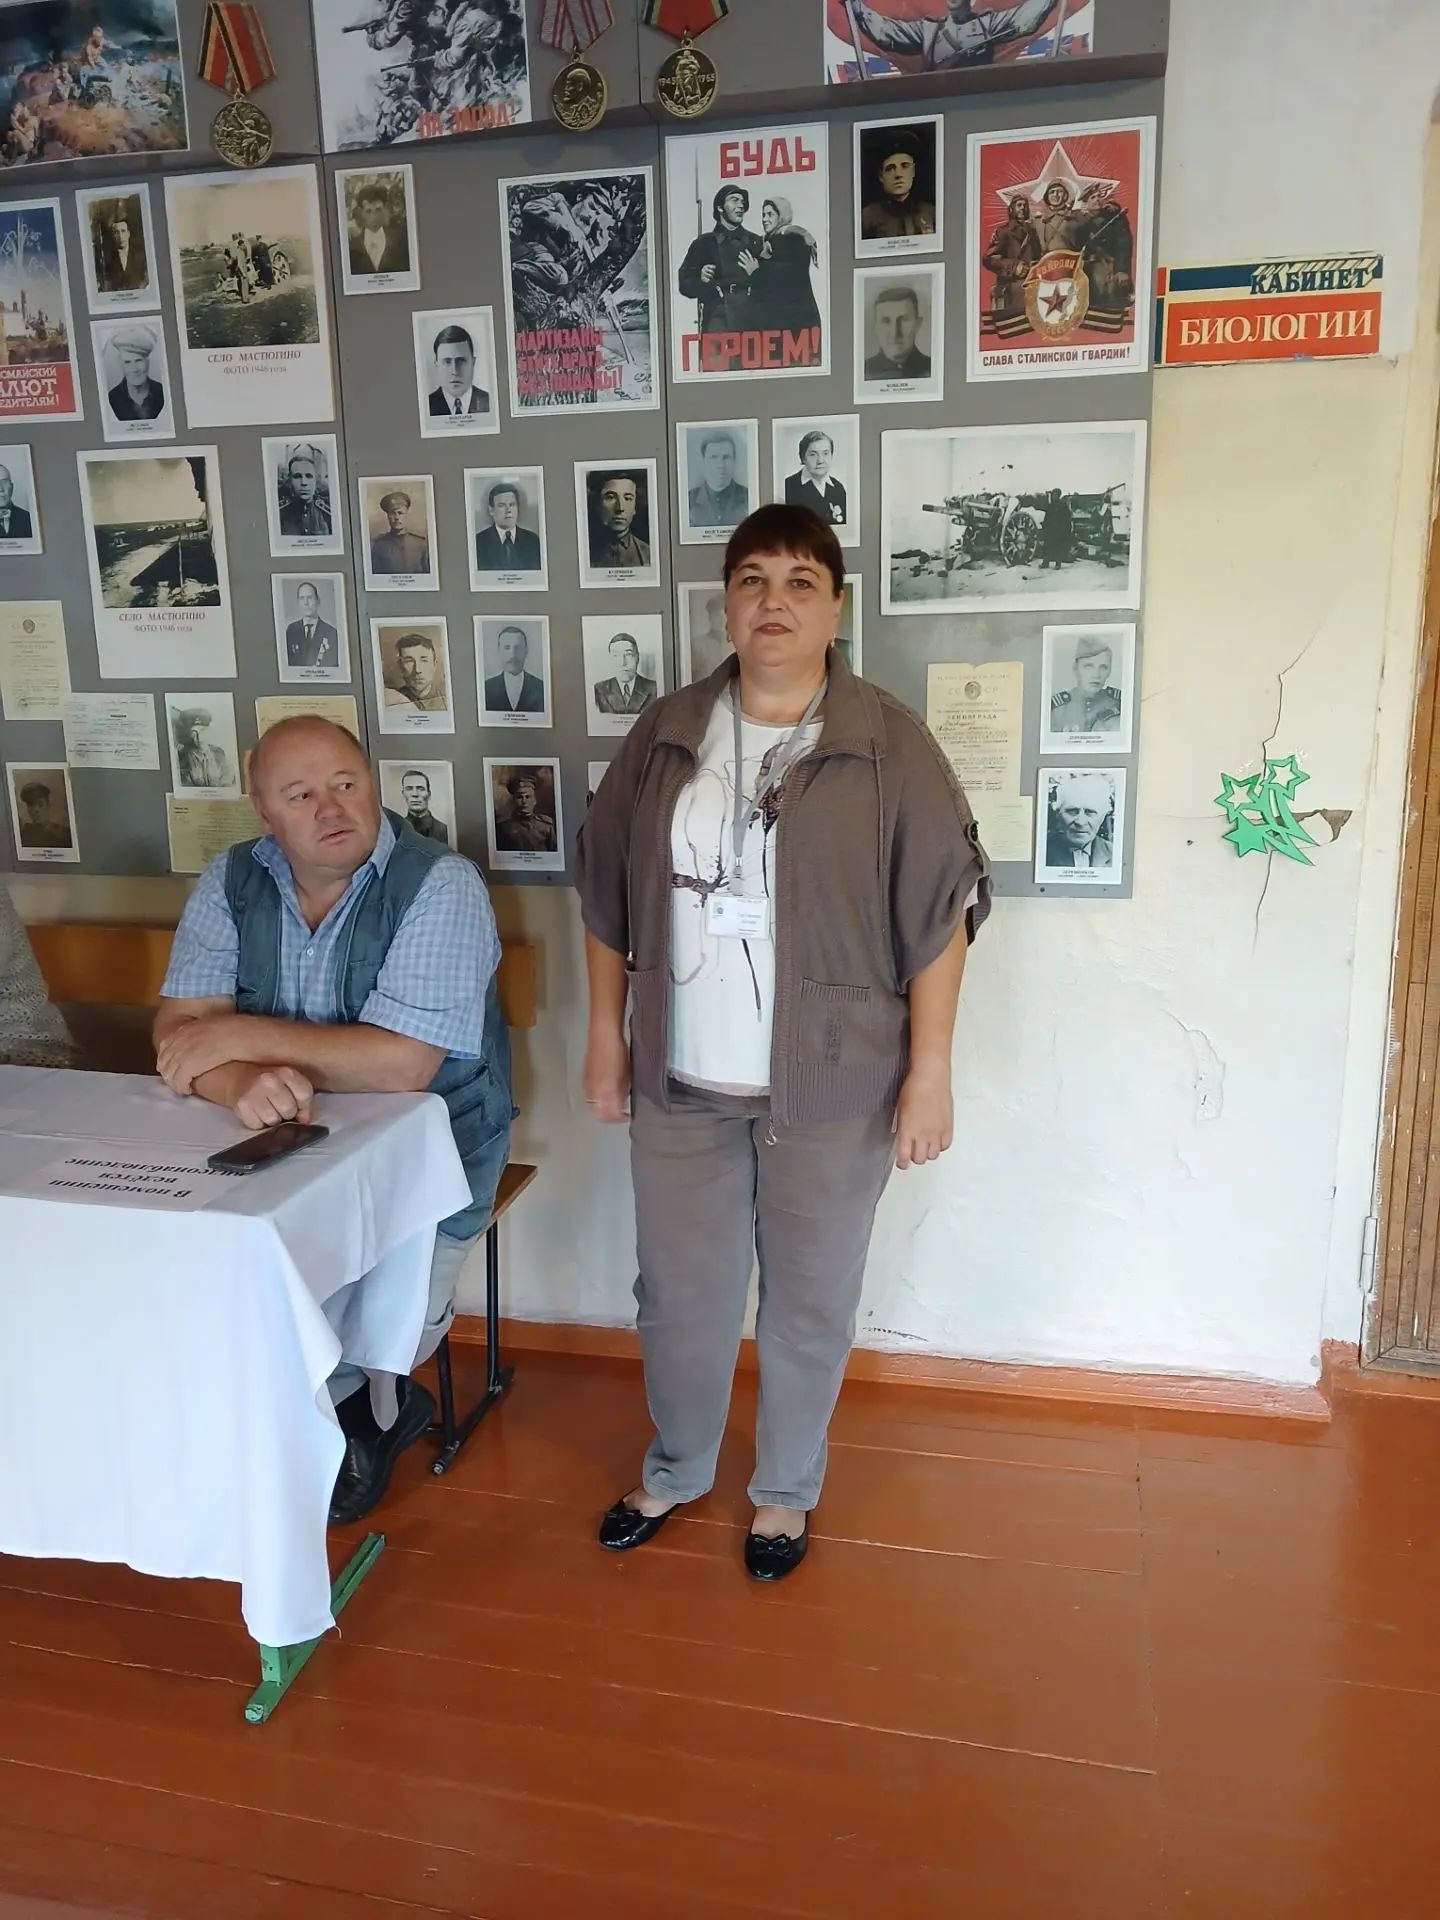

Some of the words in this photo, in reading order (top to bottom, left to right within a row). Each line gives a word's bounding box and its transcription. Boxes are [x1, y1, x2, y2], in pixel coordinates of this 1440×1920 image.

[416, 111, 443, 138] НА
[720, 136, 816, 178] БУДЬ
[1250, 263, 1373, 295] КАБИНЕТ
[1179, 310, 1373, 346] БИОЛОГИИ
[207, 353, 233, 363] СЕЛО
[682, 326, 821, 372] ГЕРОЕМ!
[983, 353, 1014, 367] СЛАВА
[1017, 350, 1079, 365] СТАЛИНСКОЙ
[1081, 346, 1131, 361] ГВАРДИИ!
[0, 366, 57, 379] ОМАЙСКИЙ
[223, 365, 249, 375] ФОТО
[49, 1178, 171, 1196] помещении
[98, 1172, 179, 1184] ведётся
[173, 1189, 193, 1198] В
